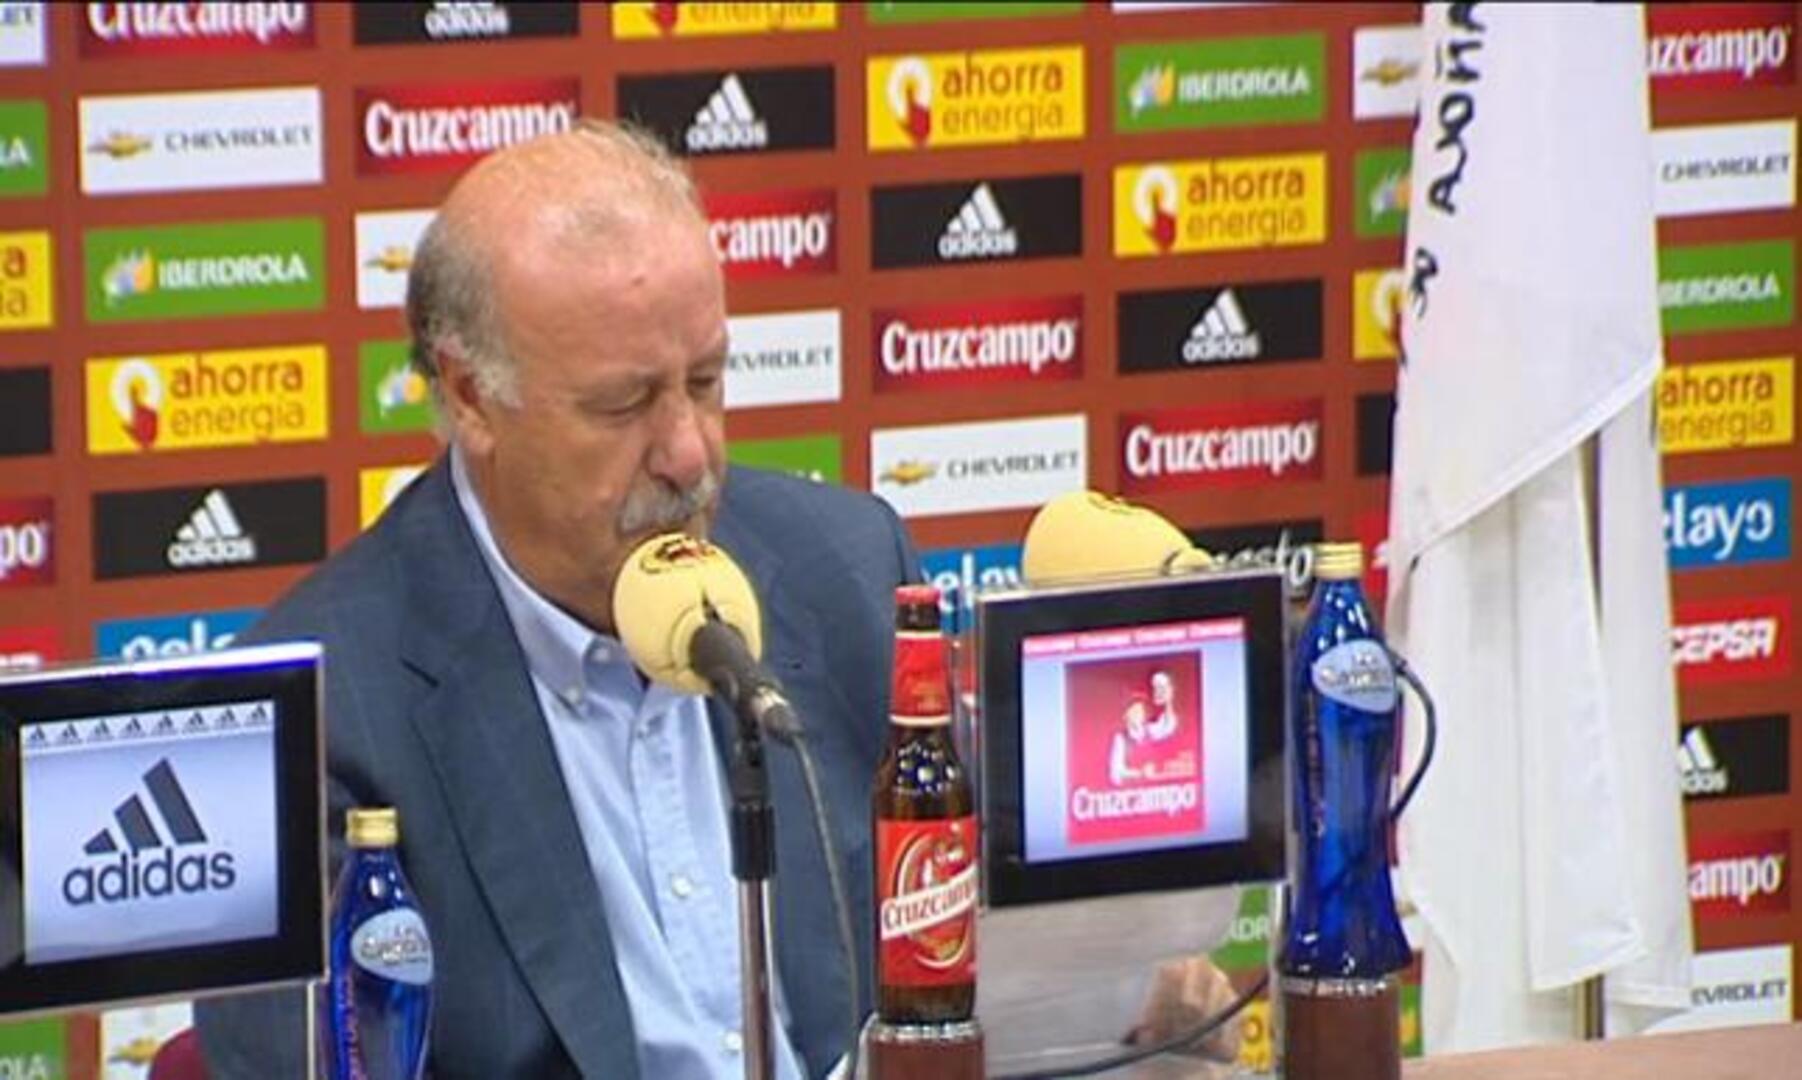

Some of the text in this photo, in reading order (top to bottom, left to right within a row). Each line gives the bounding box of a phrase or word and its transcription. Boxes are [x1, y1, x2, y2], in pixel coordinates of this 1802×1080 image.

[88, 2, 305, 43] Cruzcampo
[941, 52, 1063, 99] ahorra
[1178, 68, 1310, 100] IBERDROLA
[164, 124, 314, 153] CHEVROLET
[365, 99, 574, 157] Cruzcampo
[686, 119, 768, 150] adidas
[1187, 158, 1305, 203] ahorra
[1661, 152, 1791, 182] CHEVROLET
[938, 227, 1018, 259] adidas
[159, 254, 307, 288] IBERDROLA
[882, 318, 1077, 374] Cruzcampo
[1182, 332, 1260, 364] adidas
[169, 357, 304, 400] ahorra
[1660, 369, 1773, 408] ahorra
[947, 450, 1079, 479] CHEVROLET
[1126, 420, 1318, 476] Cruzcampo
[167, 540, 256, 568] adidas
[1071, 783, 1197, 821] Cruzcampo
[62, 848, 237, 906] adidas
